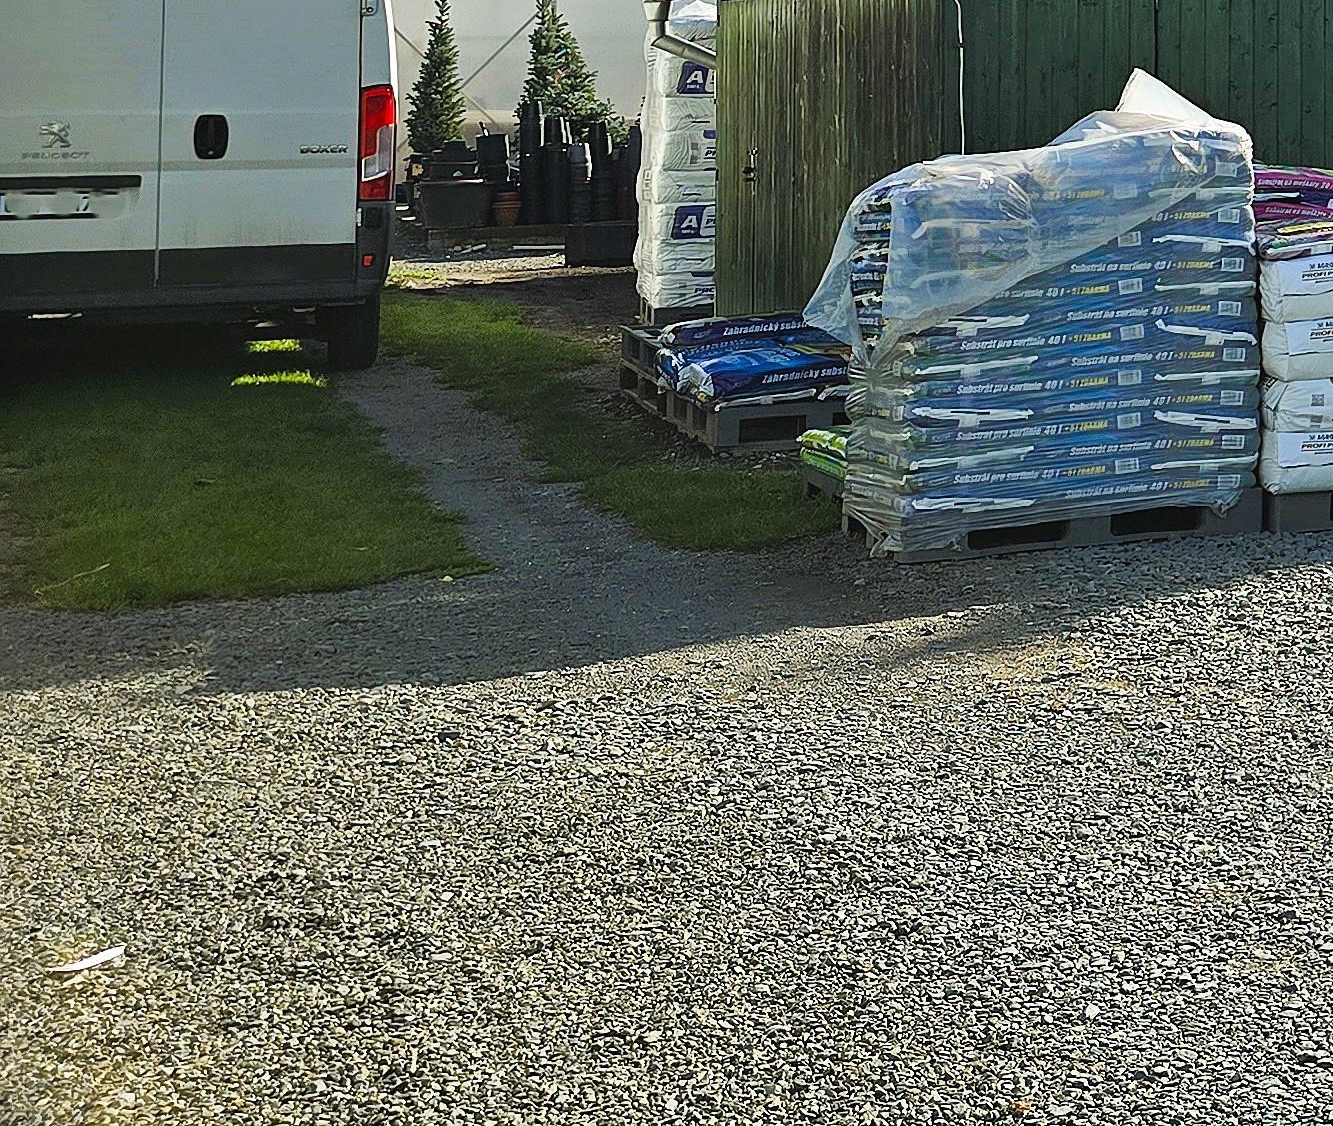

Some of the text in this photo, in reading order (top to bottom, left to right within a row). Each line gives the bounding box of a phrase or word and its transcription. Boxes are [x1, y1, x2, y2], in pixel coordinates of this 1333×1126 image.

[686, 70, 704, 84] A
[299, 143, 348, 155] BOXER
[681, 215, 699, 228] A
[1301, 442, 1327, 450] PROFI
